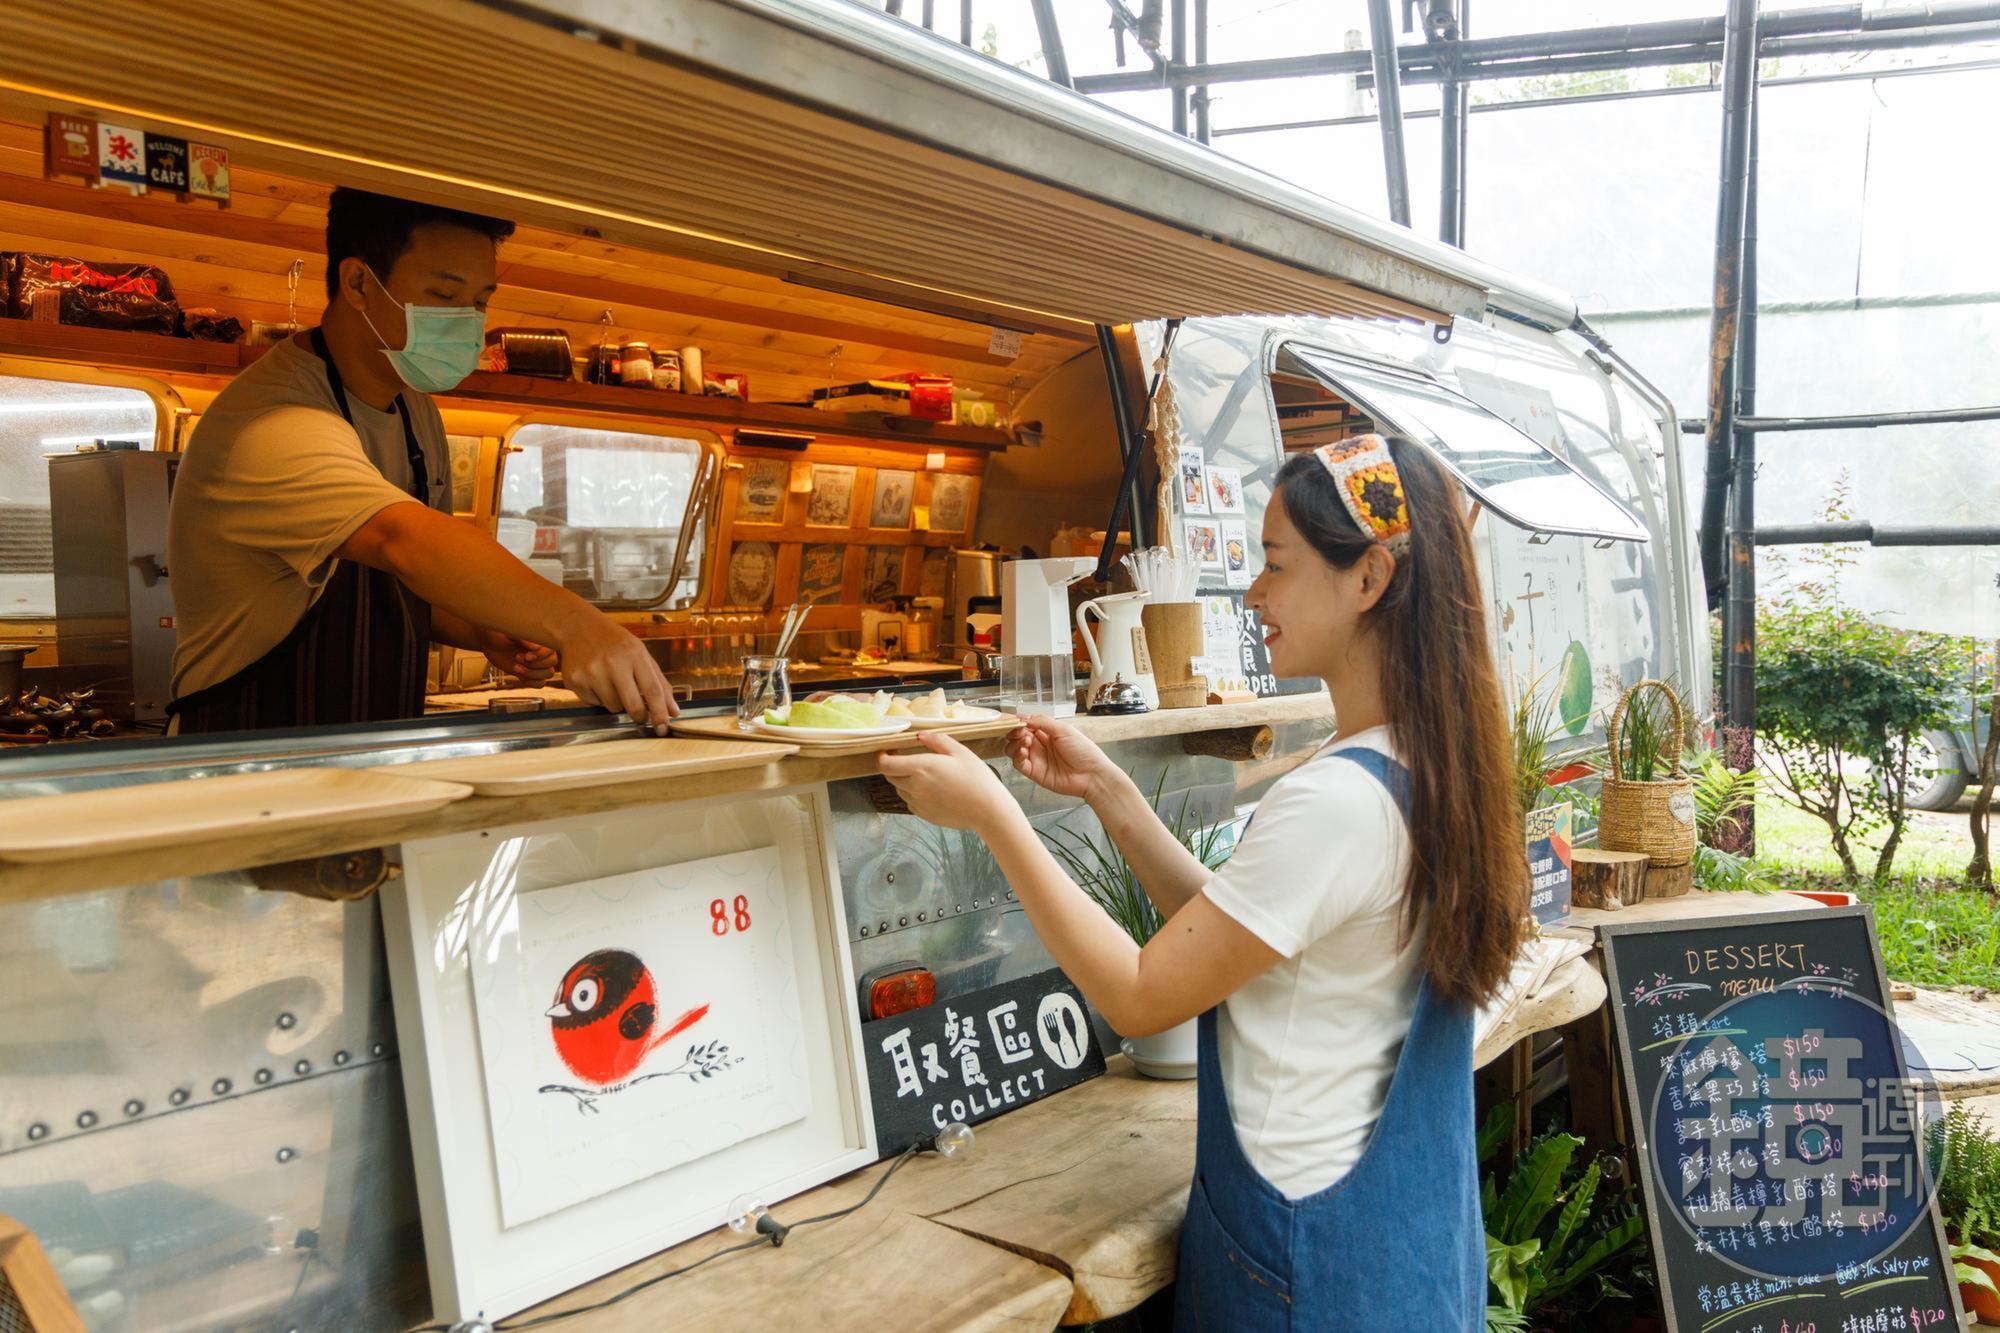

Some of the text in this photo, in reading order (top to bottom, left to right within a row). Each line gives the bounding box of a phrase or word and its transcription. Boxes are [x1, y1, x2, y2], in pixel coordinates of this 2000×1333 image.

[60, 120, 89, 133] BEER
[710, 894, 752, 936] 88
[1684, 943, 1807, 975] DESSERT
[1652, 1012, 1732, 1039] 塔類 tart
[882, 1000, 1035, 1098] 取餐區
[1783, 1033, 1821, 1060] $150
[932, 1068, 1046, 1130] COLLECT
[1668, 1067, 1826, 1112] 香蕉黑巧塔 $150
[1673, 1101, 1835, 1145] 李子乳酪塔 $150
[1849, 1170, 1888, 1198] $130
[1857, 1211, 1898, 1236] $130
[1912, 1255, 1930, 1272] pie
[1765, 1277, 1793, 1294] mini
[1798, 1273, 1822, 1287] cake
[1909, 1306, 1946, 1333] $120
